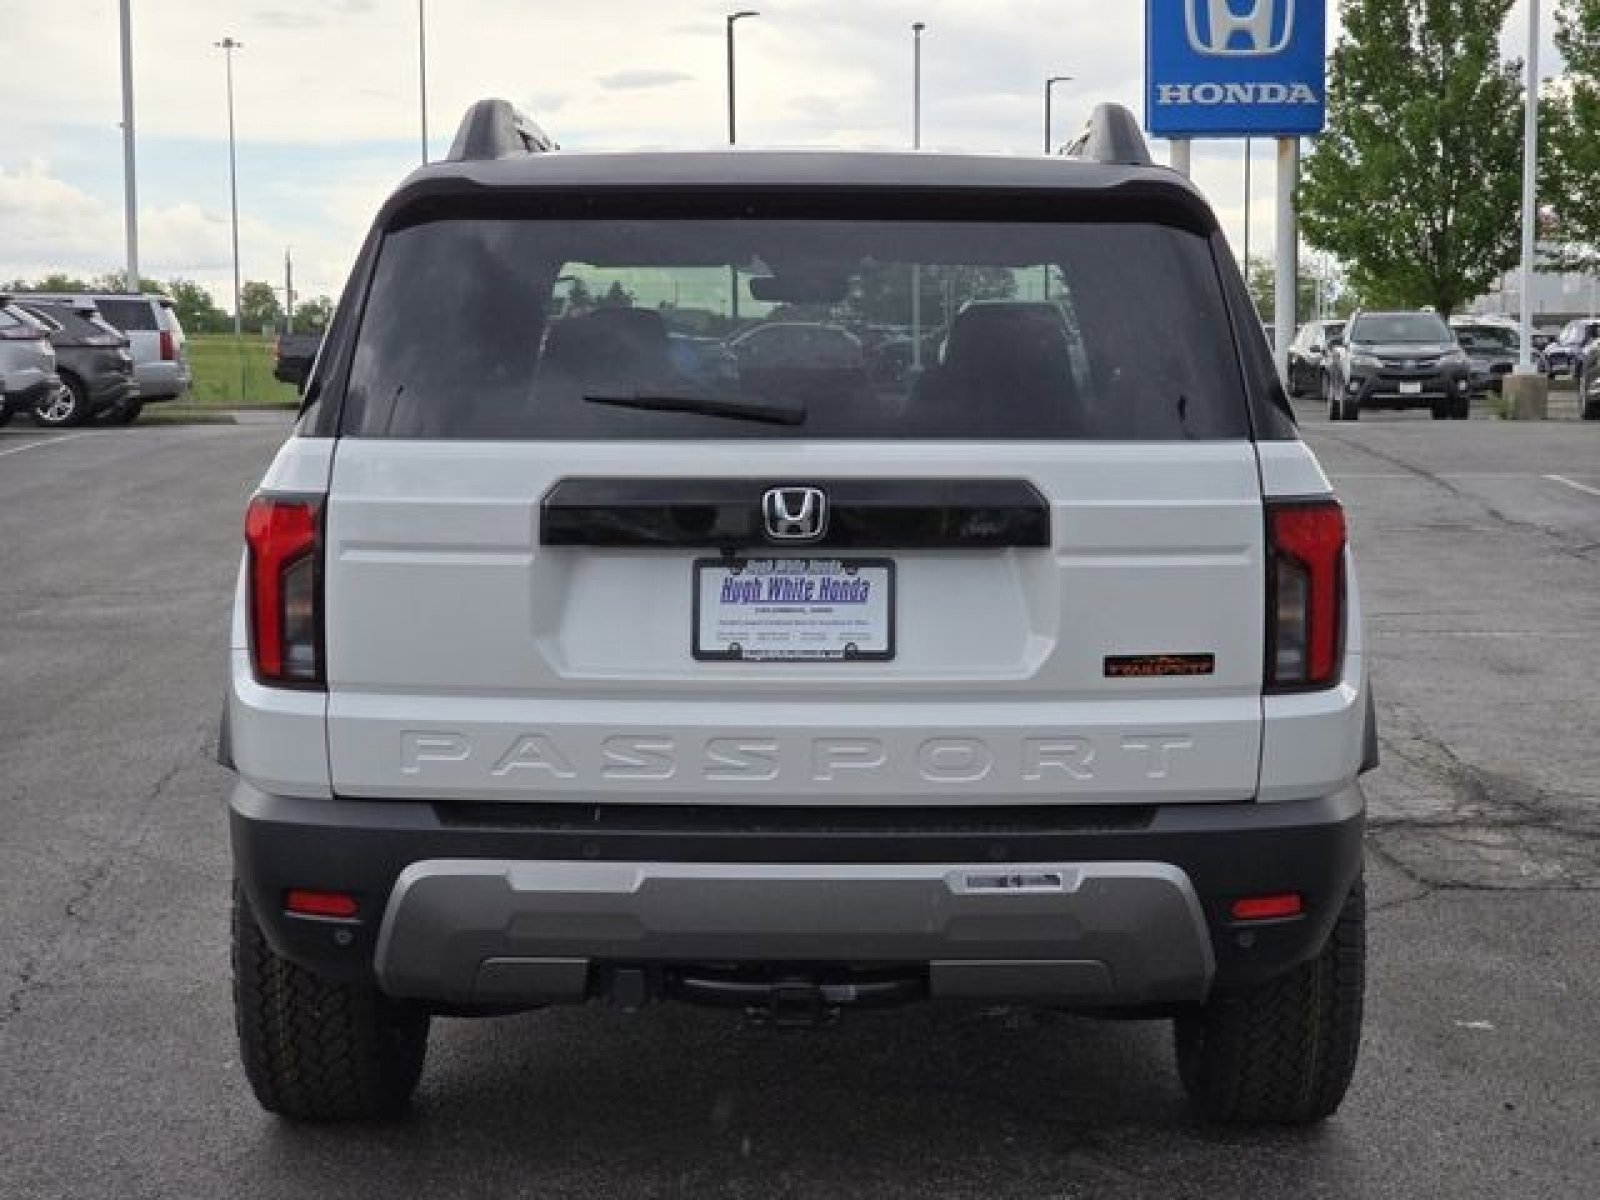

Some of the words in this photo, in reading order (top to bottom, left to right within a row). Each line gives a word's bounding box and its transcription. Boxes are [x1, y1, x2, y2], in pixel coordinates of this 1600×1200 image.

[1157, 83, 1318, 104] HONDA
[721, 576, 762, 604] Hugh
[768, 576, 815, 601] White
[819, 576, 870, 601] Honda
[400, 729, 1193, 782] PASSPORT
